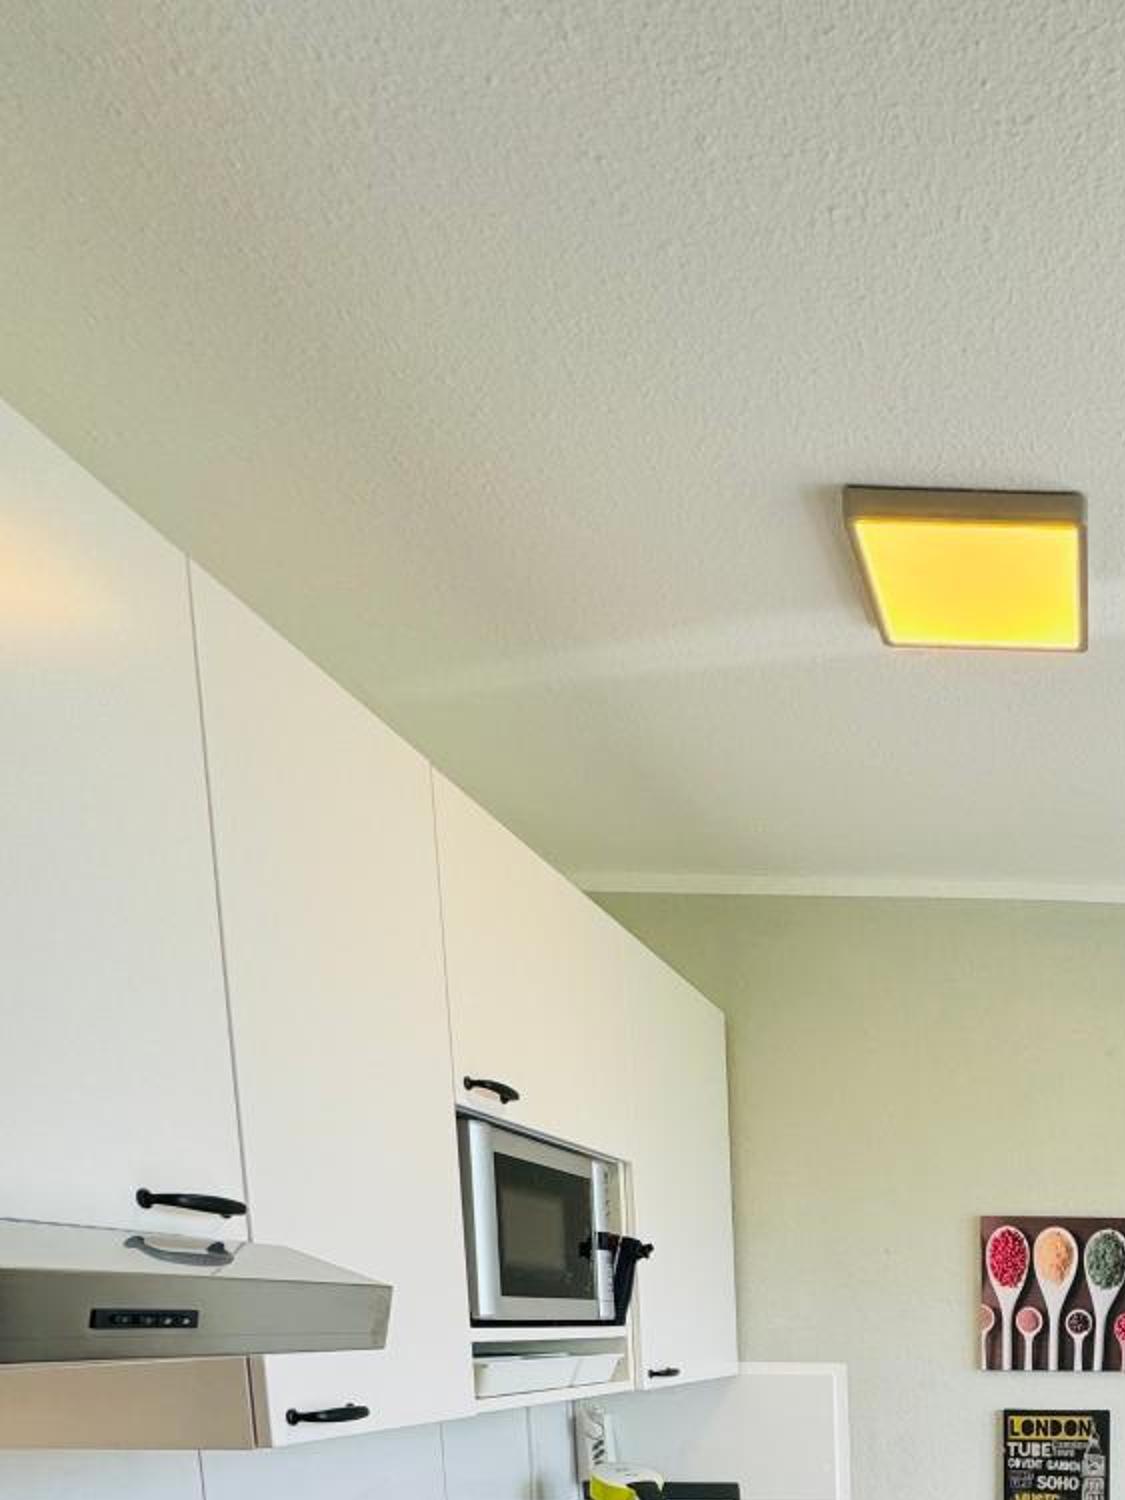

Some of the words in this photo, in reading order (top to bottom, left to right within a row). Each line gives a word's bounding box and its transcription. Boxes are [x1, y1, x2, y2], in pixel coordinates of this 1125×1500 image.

[1010, 1419, 1091, 1437] LONDON
[1007, 1442, 1052, 1457] TUBE
[1037, 1475, 1079, 1491] SOHO
